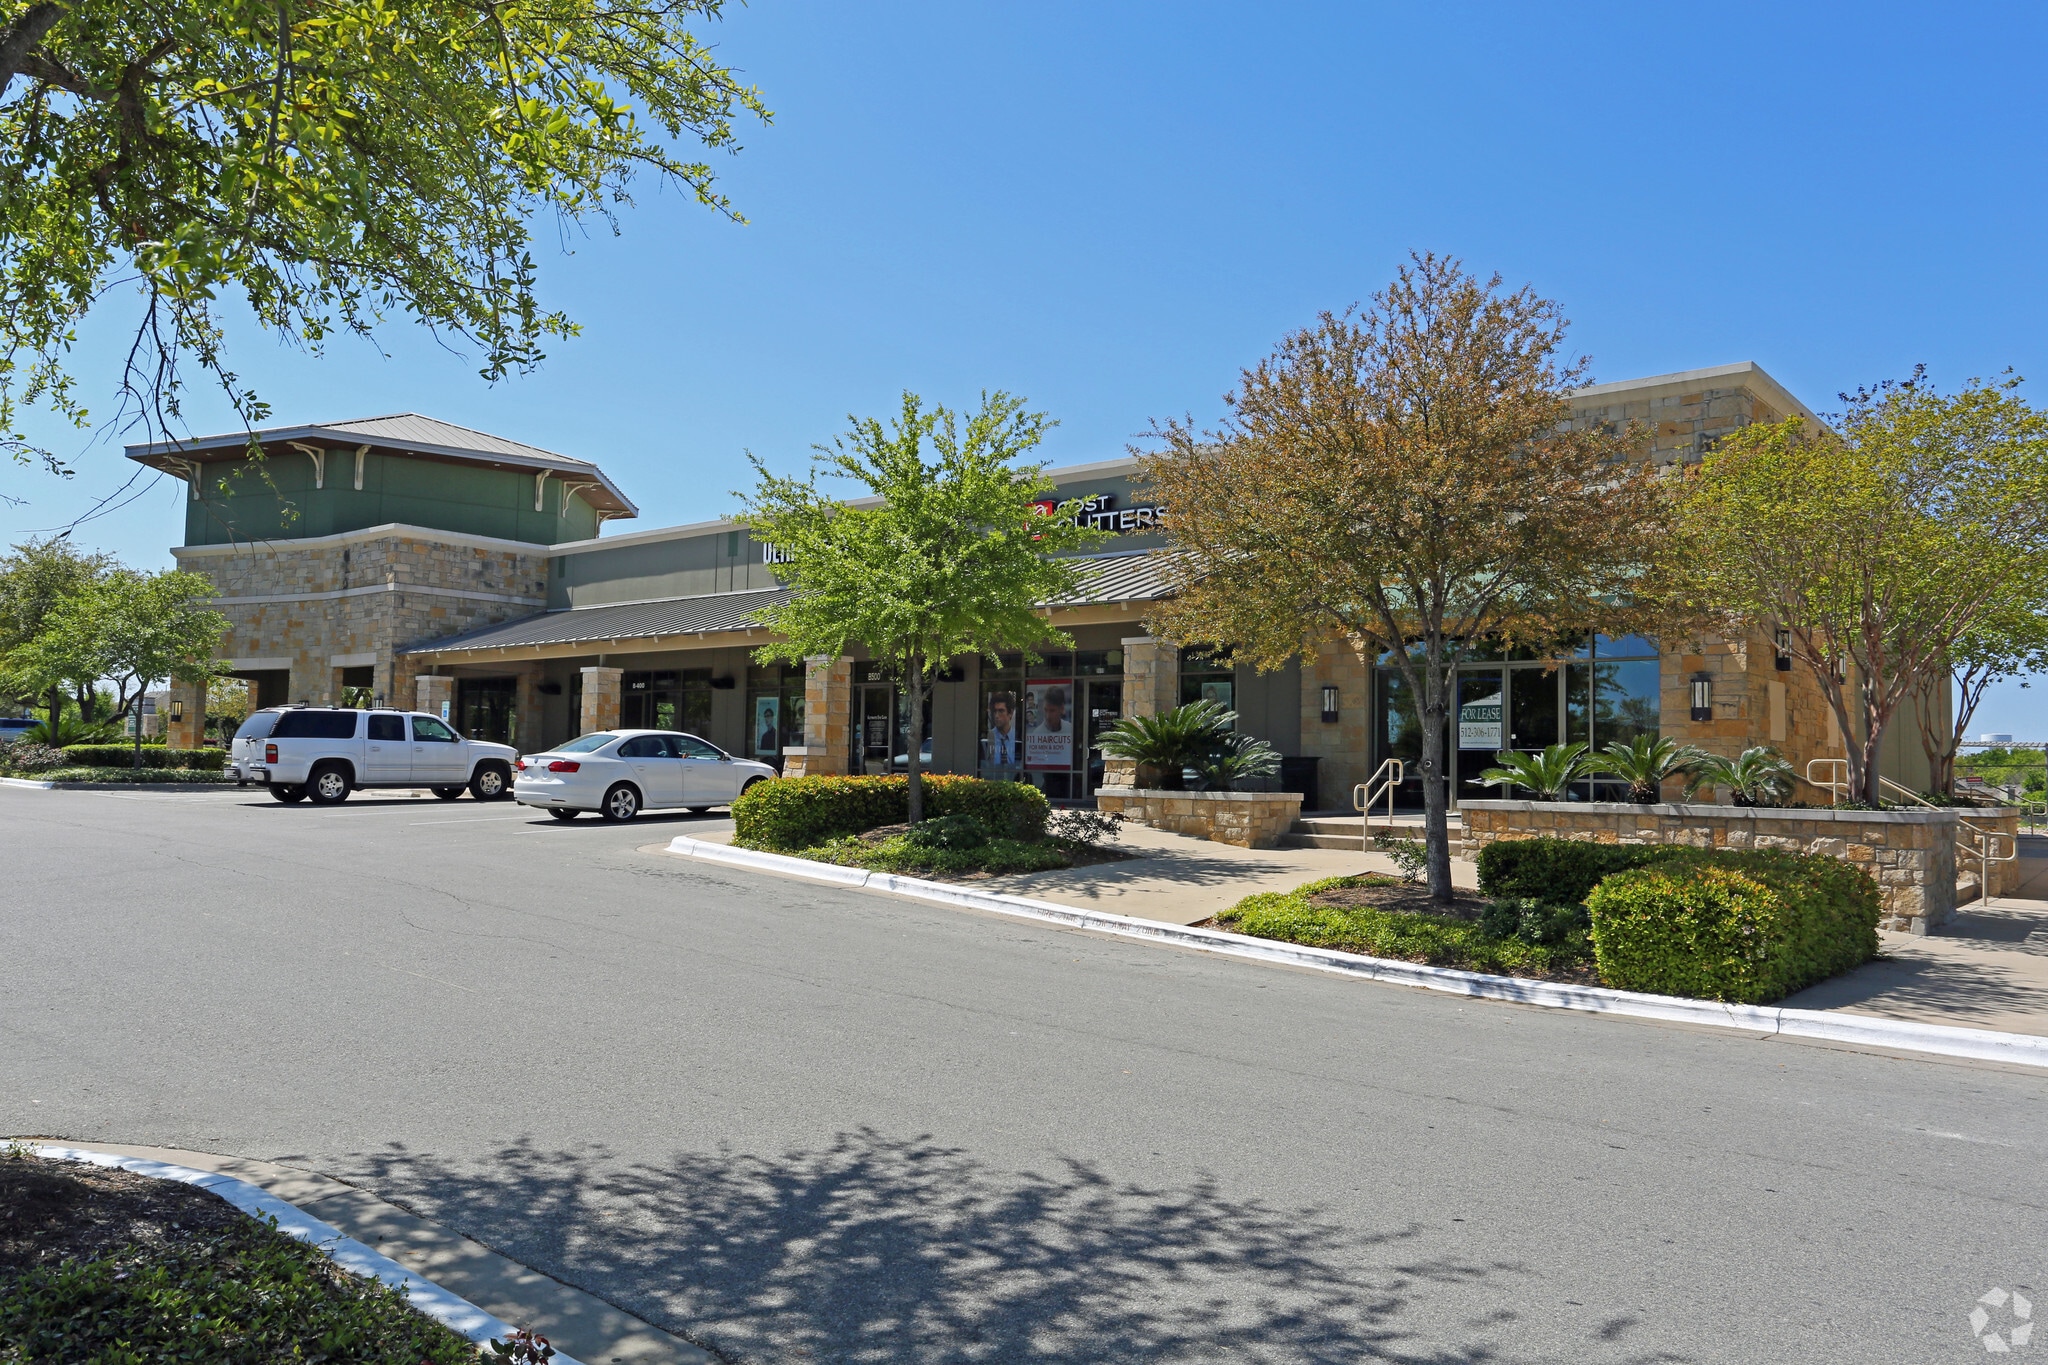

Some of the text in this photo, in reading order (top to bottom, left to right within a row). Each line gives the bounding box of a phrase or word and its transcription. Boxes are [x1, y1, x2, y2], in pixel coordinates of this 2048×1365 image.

[1461, 707, 1501, 720] FOR LEASE
[1037, 735, 1071, 744] HAIRCUTS
